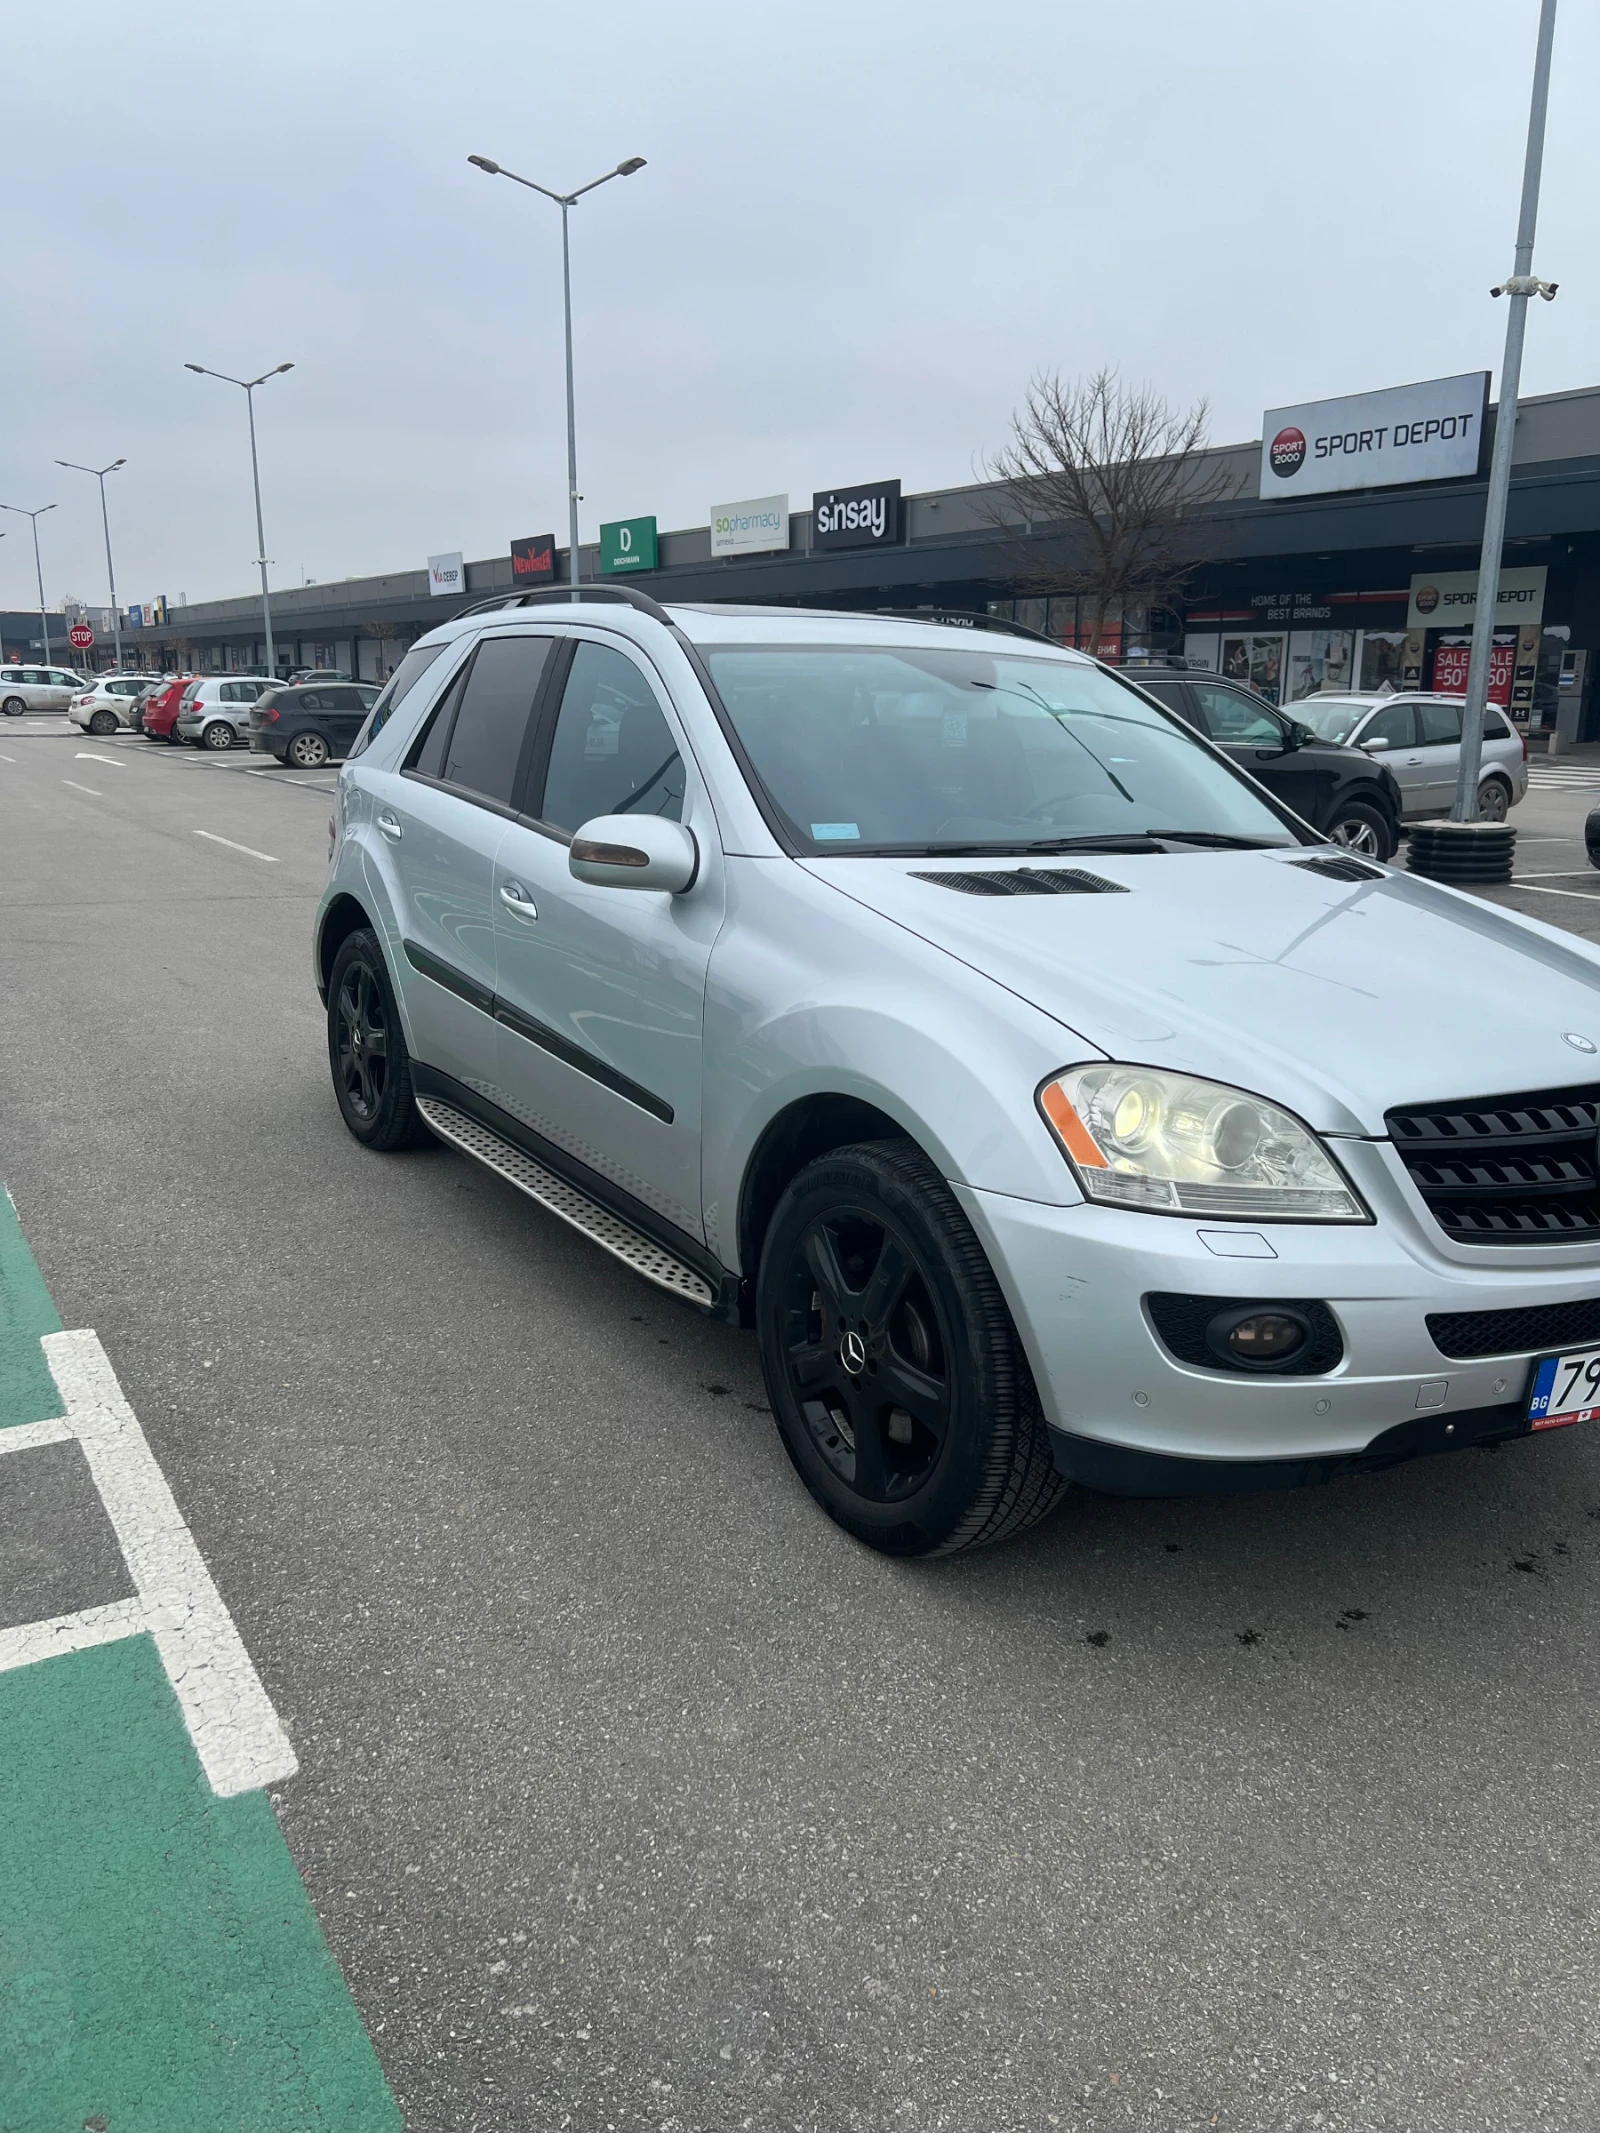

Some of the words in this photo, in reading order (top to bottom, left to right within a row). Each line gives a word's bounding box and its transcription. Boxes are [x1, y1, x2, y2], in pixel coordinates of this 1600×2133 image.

[1314, 427, 1388, 459] SPORT
[1393, 413, 1473, 447] DEPOT
[1272, 440, 1304, 455] SPORT
[1274, 452, 1300, 465] 2000
[716, 511, 781, 536] sopharmacy
[818, 495, 885, 538] sinsay
[620, 527, 632, 552] D
[613, 555, 640, 566] DEICHMANN
[1251, 594, 1277, 607] HOME
[1279, 594, 1292, 605] OF
[1295, 593, 1312, 605] THE
[1443, 592, 1477, 606] SPOR
[1496, 589, 1537, 603] EPOT
[1267, 608, 1291, 620] BEST
[1292, 606, 1331, 619] BRANDS
[71, 632, 92, 642] STOP
[1188, 659, 1209, 669] TRAIN
[1437, 652, 1469, 667] SALE
[1490, 651, 1514, 666] ALE
[1531, 1395, 1549, 1411] BG
